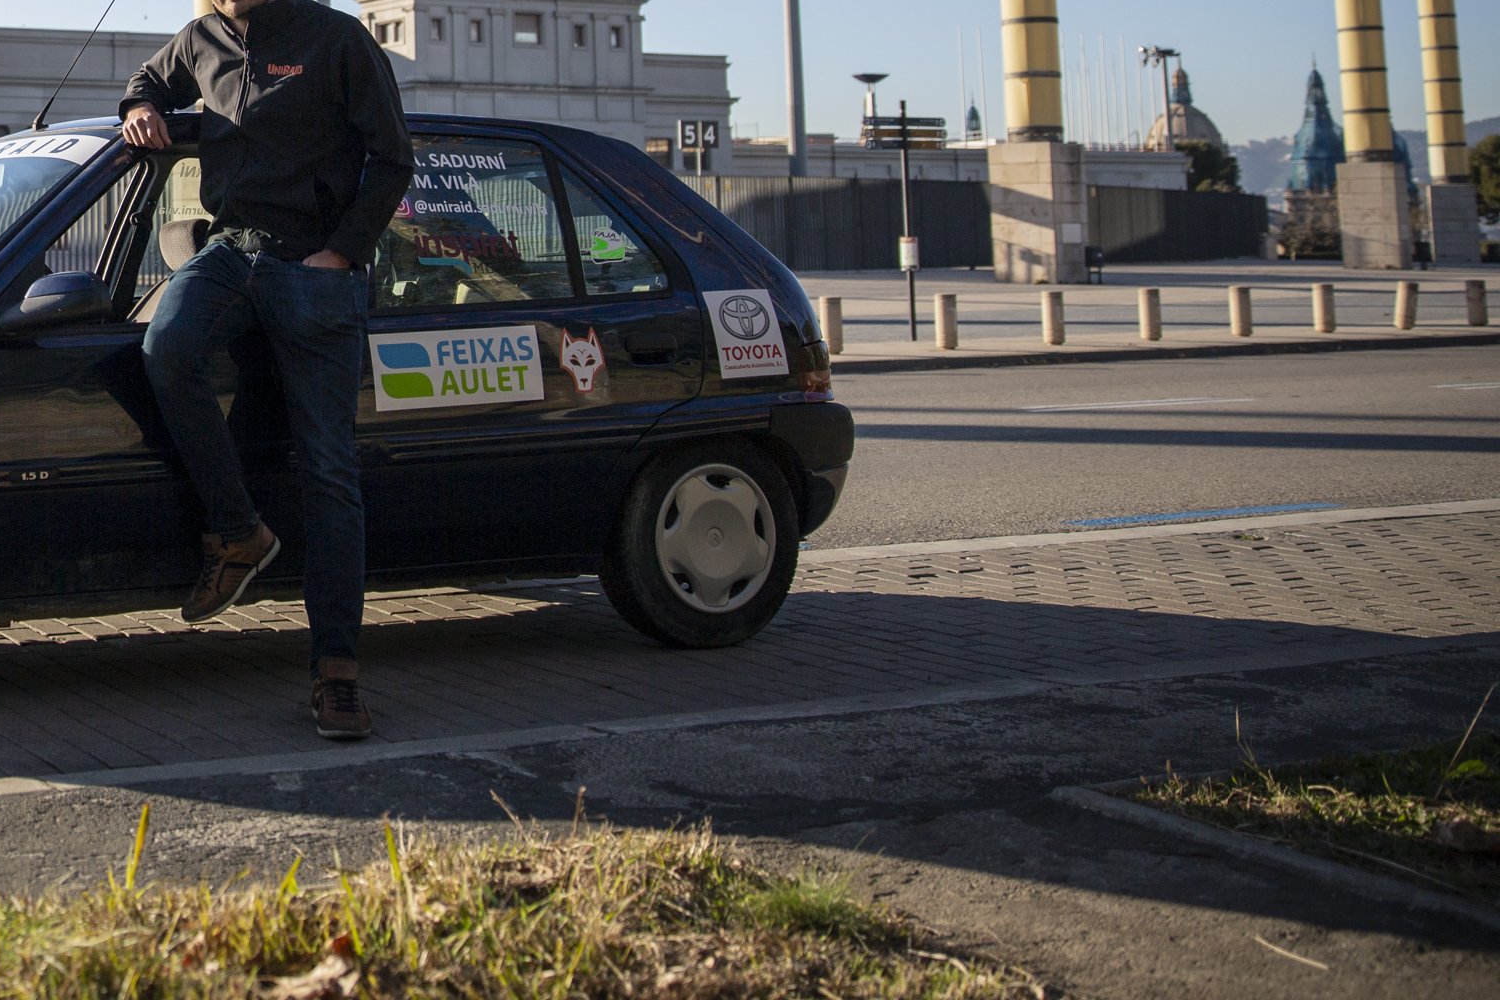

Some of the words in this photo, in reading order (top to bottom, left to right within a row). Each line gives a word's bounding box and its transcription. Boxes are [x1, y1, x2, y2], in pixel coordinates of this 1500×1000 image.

[685, 124, 696, 145] 5
[704, 124, 716, 145] 4
[429, 152, 506, 170] SADURNÍ
[413, 174, 438, 190] M.
[439, 172, 481, 192] VILÀ
[436, 335, 534, 367] FEIXAS
[721, 344, 783, 362] TOYOTA
[441, 365, 529, 397] AULET
[40, 471, 49, 480] D
